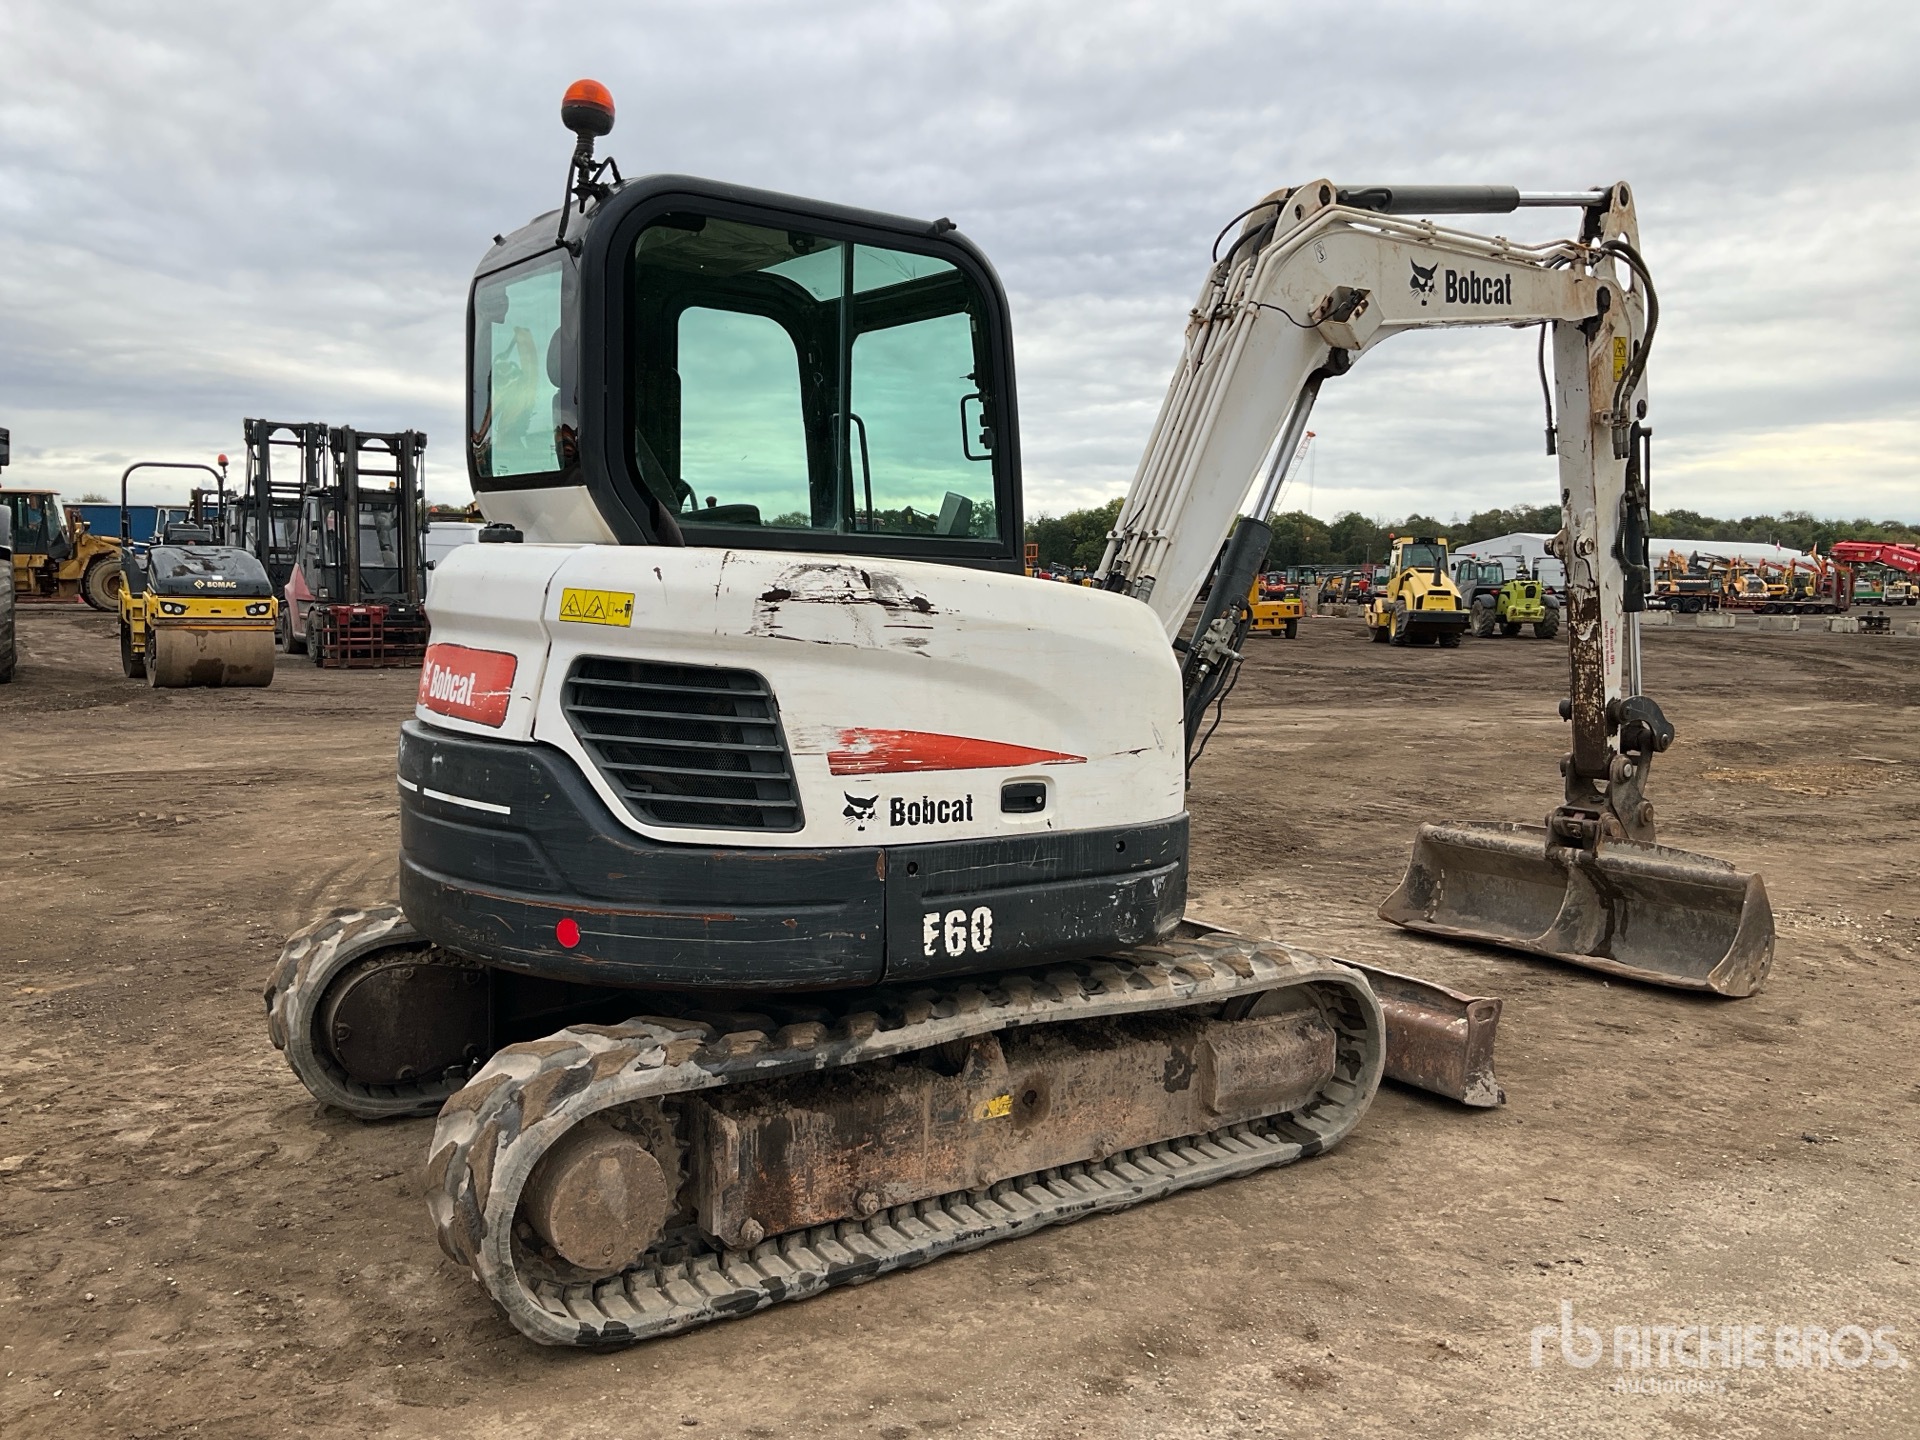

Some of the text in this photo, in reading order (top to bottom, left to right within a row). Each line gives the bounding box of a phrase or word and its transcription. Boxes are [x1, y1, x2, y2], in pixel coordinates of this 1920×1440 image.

[1445, 269, 1512, 305] Bobcat
[429, 664, 476, 707] Bobcat
[890, 794, 973, 827] Bobcat
[923, 906, 994, 957] E60
